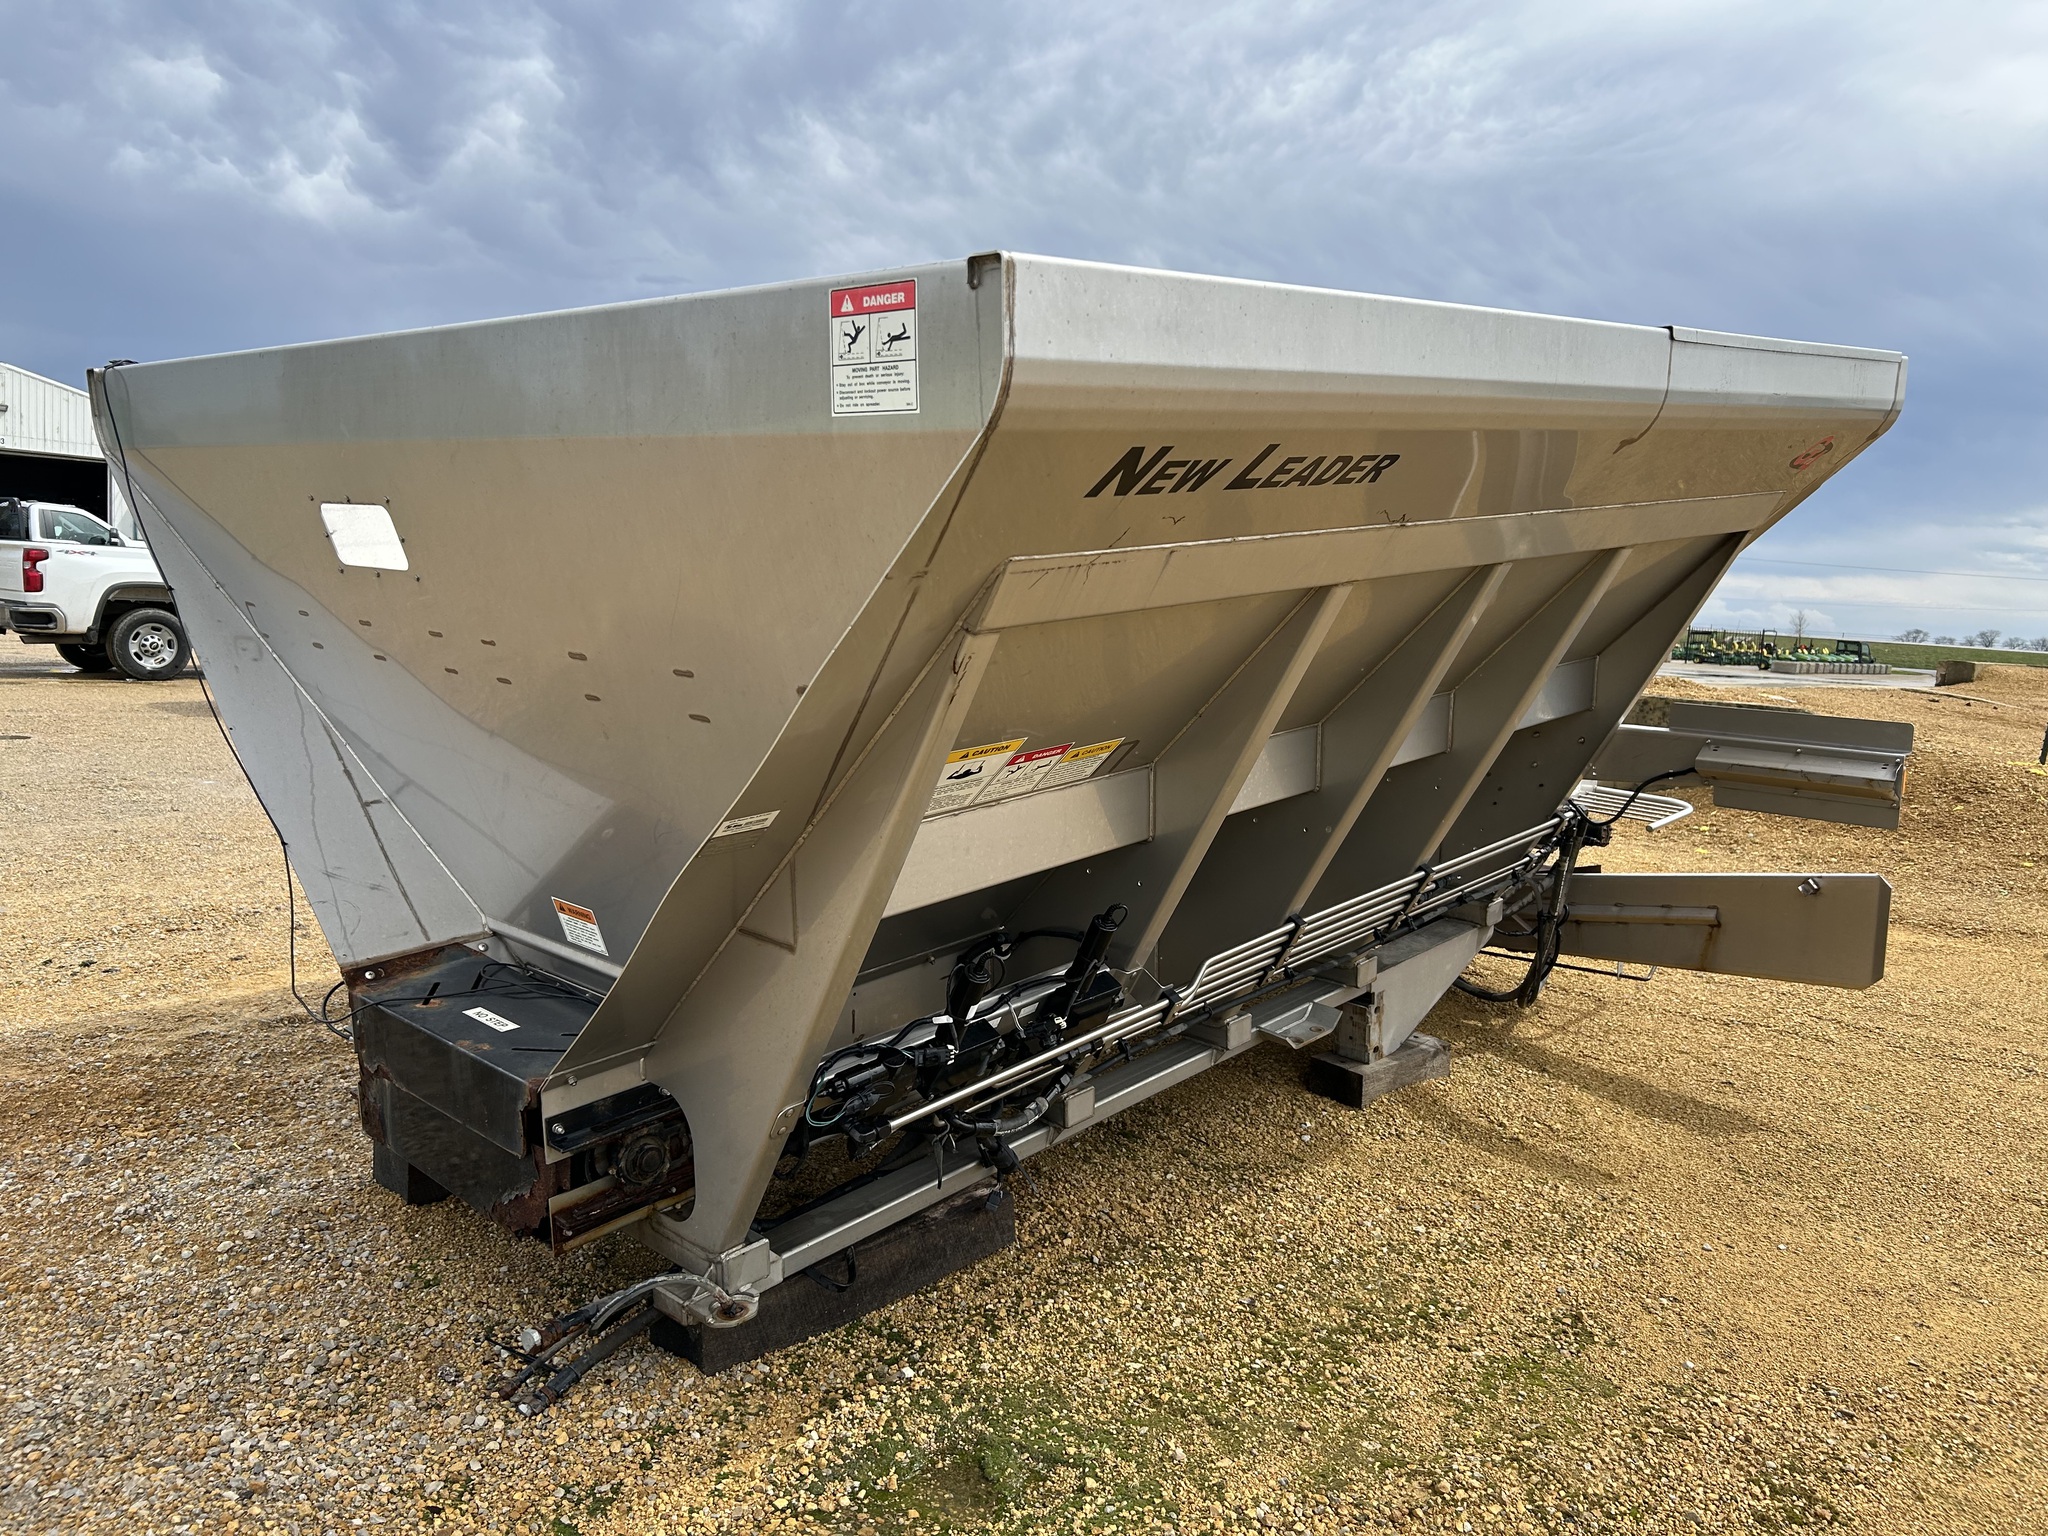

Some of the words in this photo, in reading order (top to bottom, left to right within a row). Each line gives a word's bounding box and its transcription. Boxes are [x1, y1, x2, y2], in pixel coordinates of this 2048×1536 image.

[863, 292, 905, 308] DANGER
[971, 744, 1011, 757] CAUTION
[1031, 748, 1062, 759] DANGER
[1081, 744, 1113, 756] CAUTION
[472, 1010, 489, 1018] NO
[485, 1016, 509, 1027] STEP
